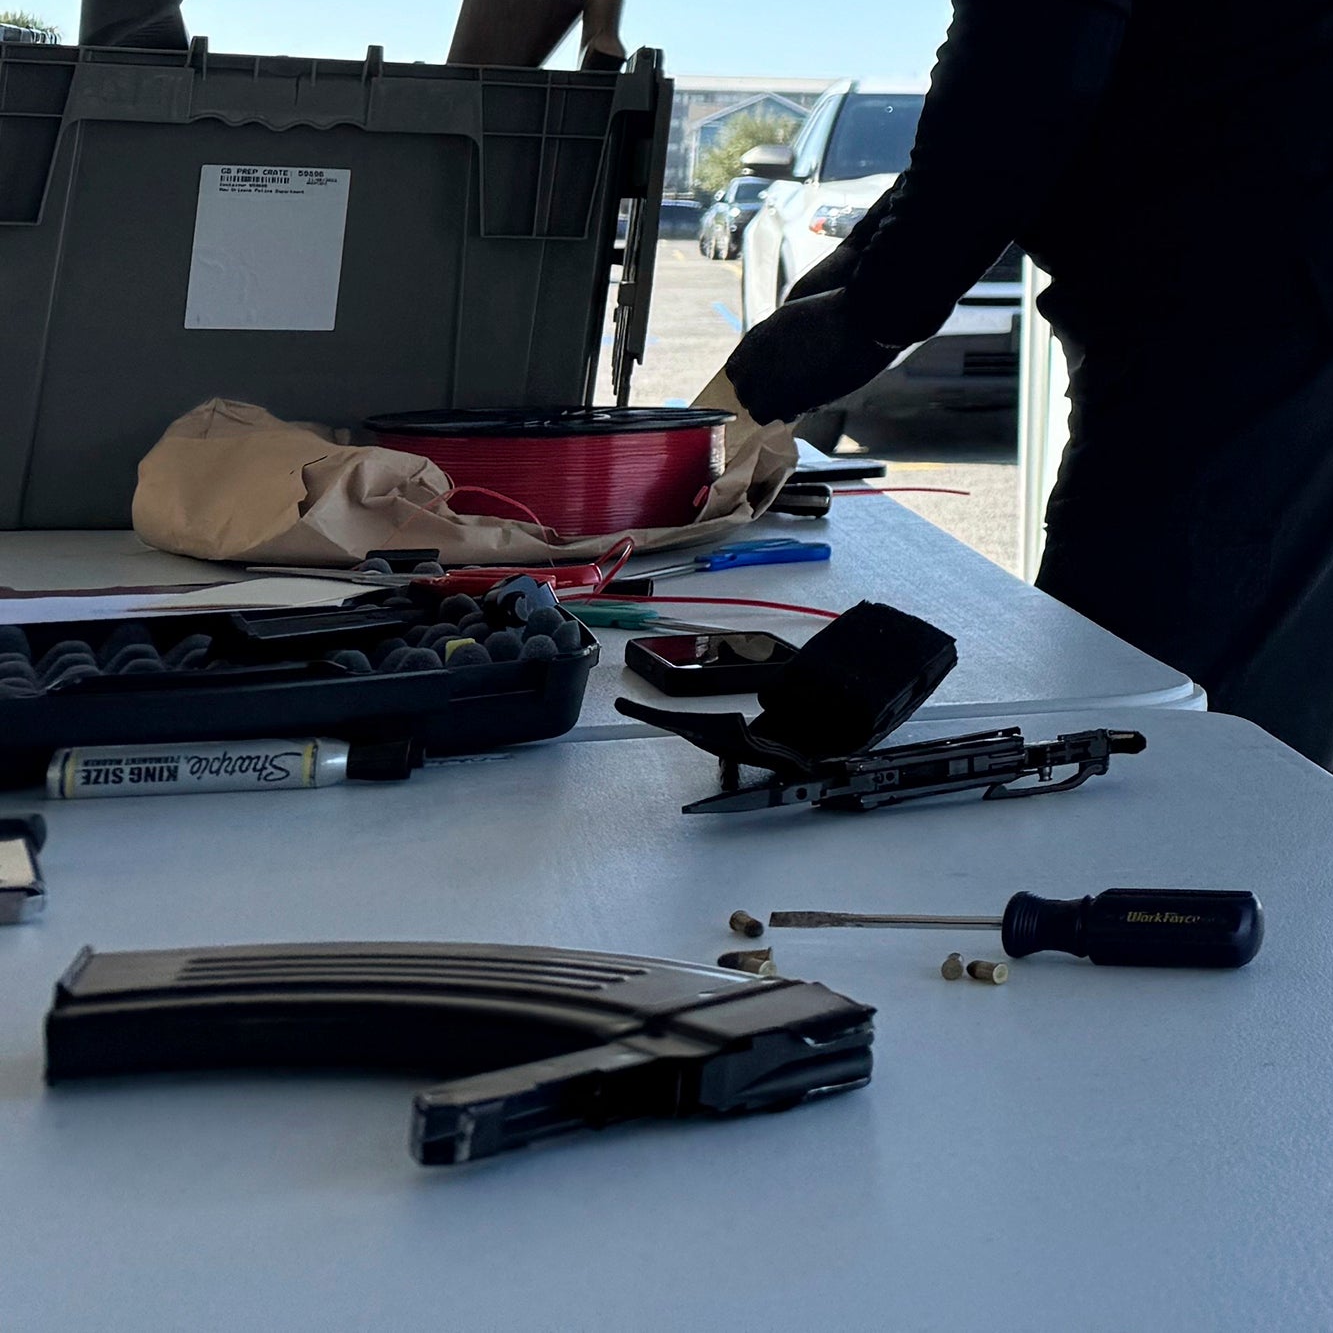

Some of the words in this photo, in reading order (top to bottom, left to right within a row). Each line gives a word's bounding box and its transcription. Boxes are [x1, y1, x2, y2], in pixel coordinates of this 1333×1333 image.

[79, 766, 124, 786] SIZE
[128, 765, 179, 785] KING
[187, 750, 302, 782] Sharpie
